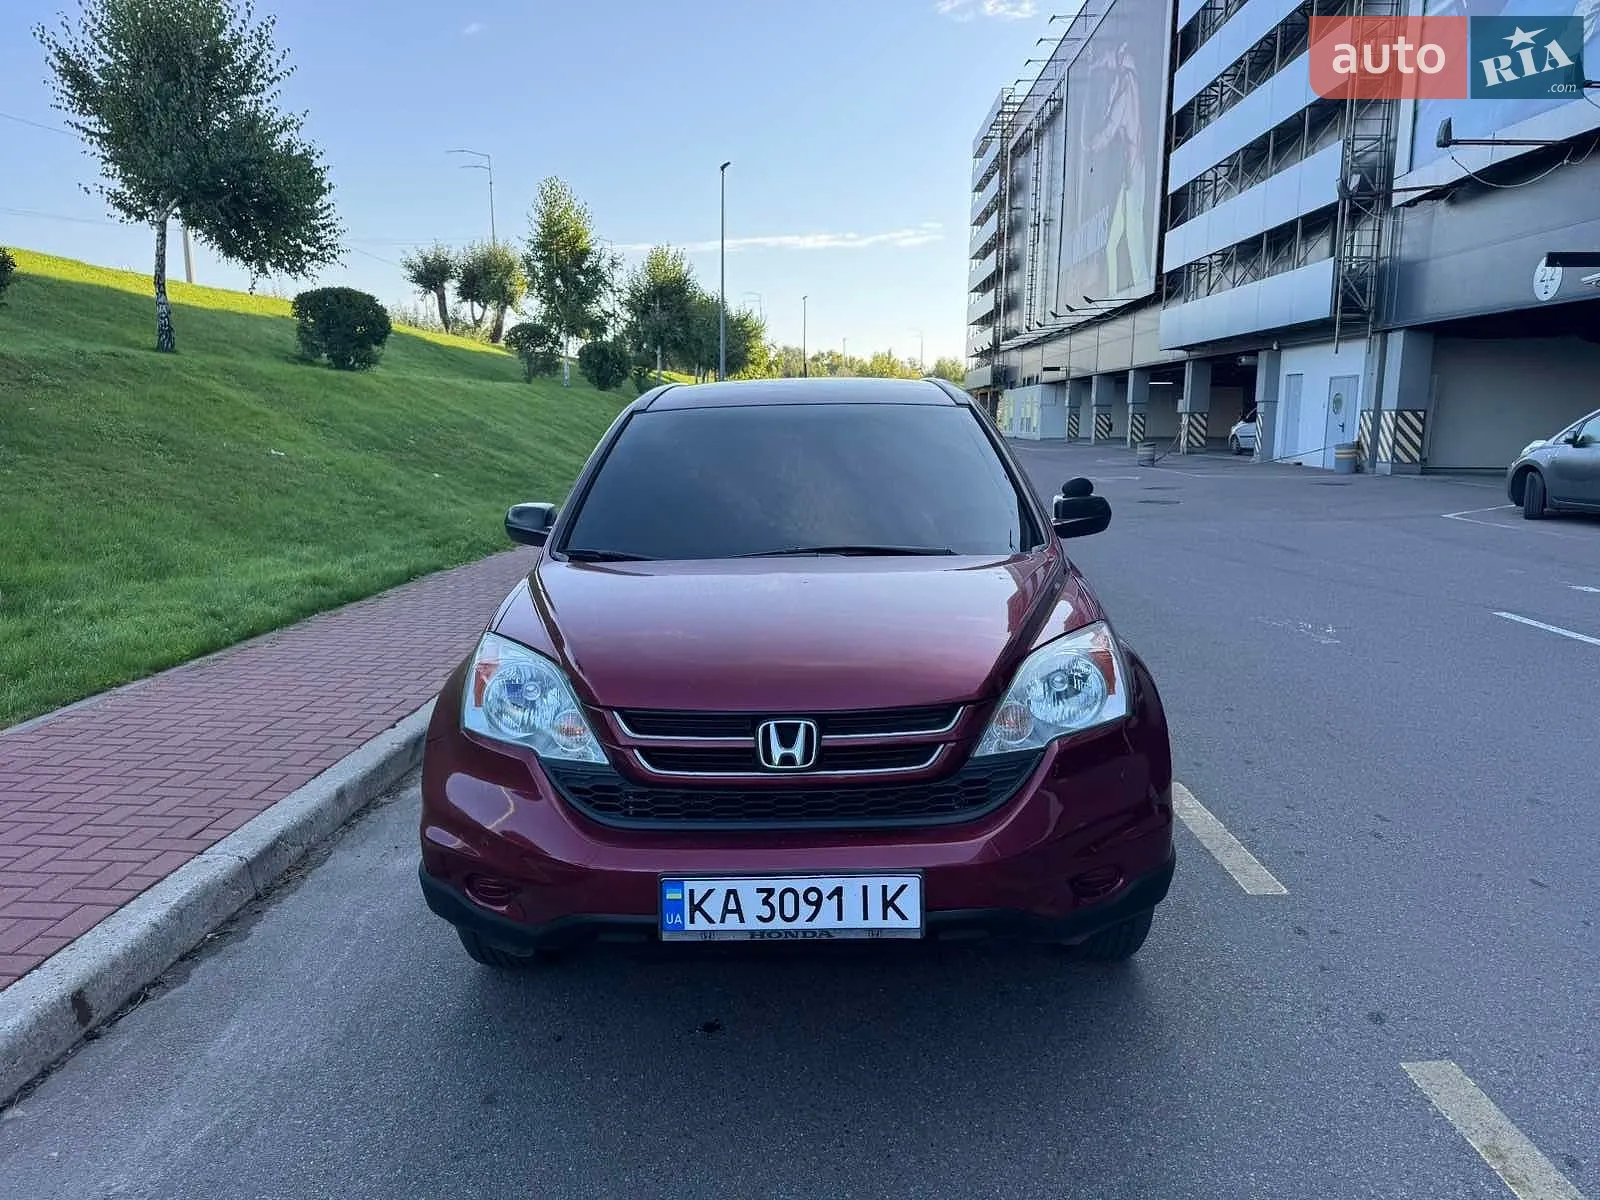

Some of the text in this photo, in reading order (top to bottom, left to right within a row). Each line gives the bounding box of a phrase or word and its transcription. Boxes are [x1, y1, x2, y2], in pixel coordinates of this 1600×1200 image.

[688, 884, 909, 925] KA 3091 IK
[666, 913, 683, 925] UA
[749, 929, 835, 940] HONDA
